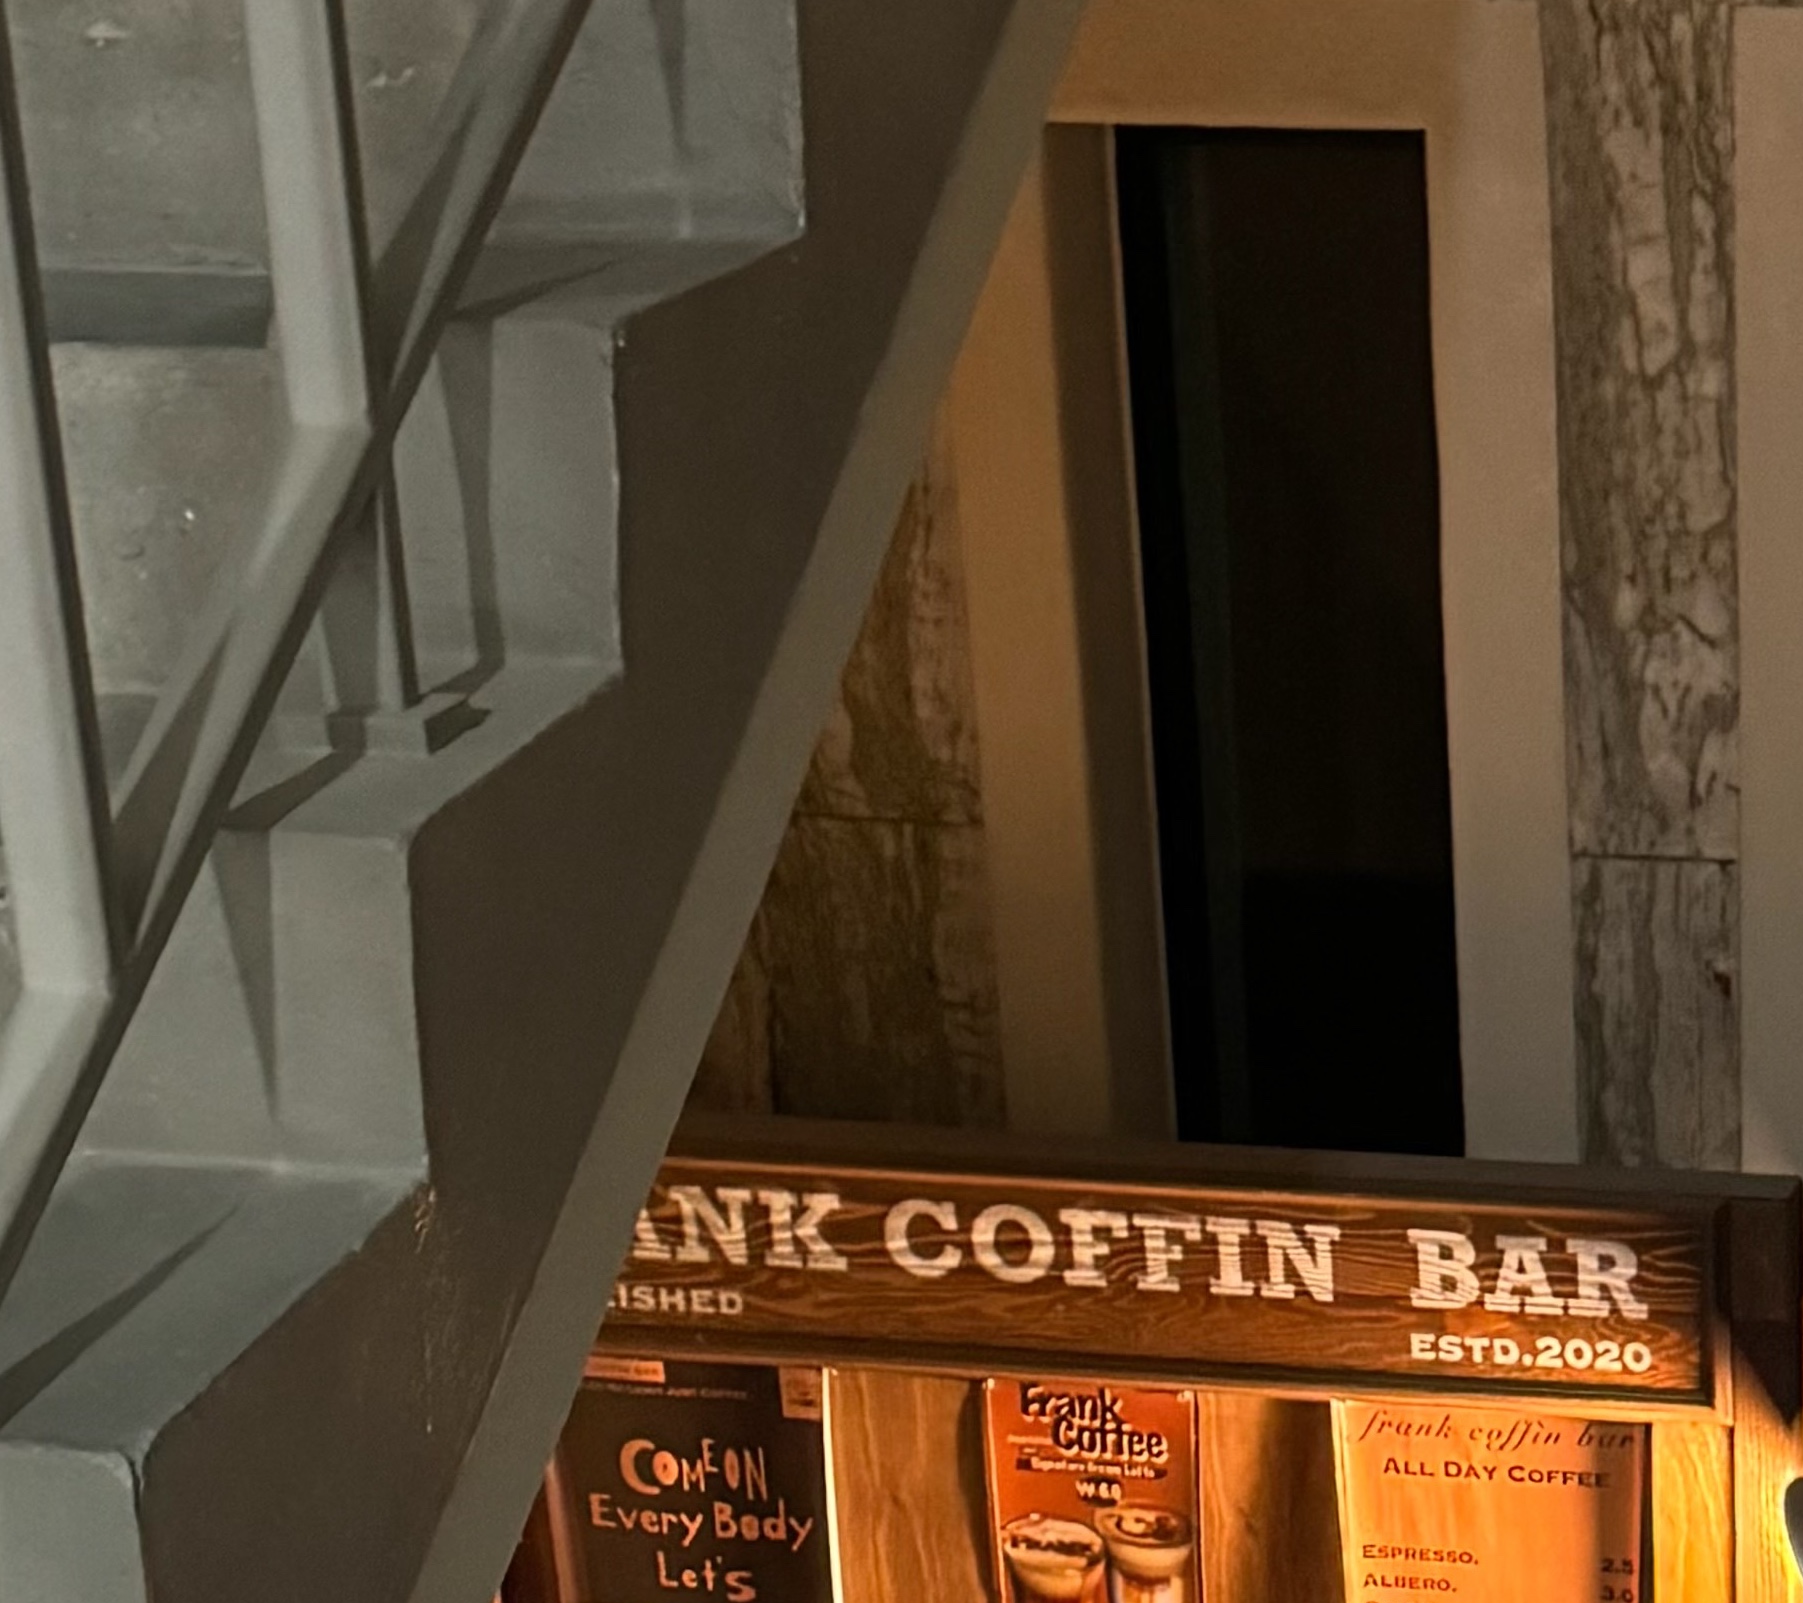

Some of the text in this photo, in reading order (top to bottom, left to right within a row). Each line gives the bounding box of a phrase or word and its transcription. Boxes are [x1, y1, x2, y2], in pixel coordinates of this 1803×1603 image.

[884, 1199, 1341, 1302] COFFIN
[1406, 1228, 1649, 1320] BAR
[607, 1284, 743, 1315] ISHED
[1409, 1333, 1652, 1373] ESTD.2020
[1019, 1381, 1124, 1427] Frank
[1051, 1415, 1169, 1464] Coffee
[1358, 1409, 1635, 1451] frank coffin bar
[1383, 1457, 1613, 1489] ALL DAY COFFEE
[588, 1492, 814, 1552] Every Body
[656, 1550, 757, 1602] Let's
